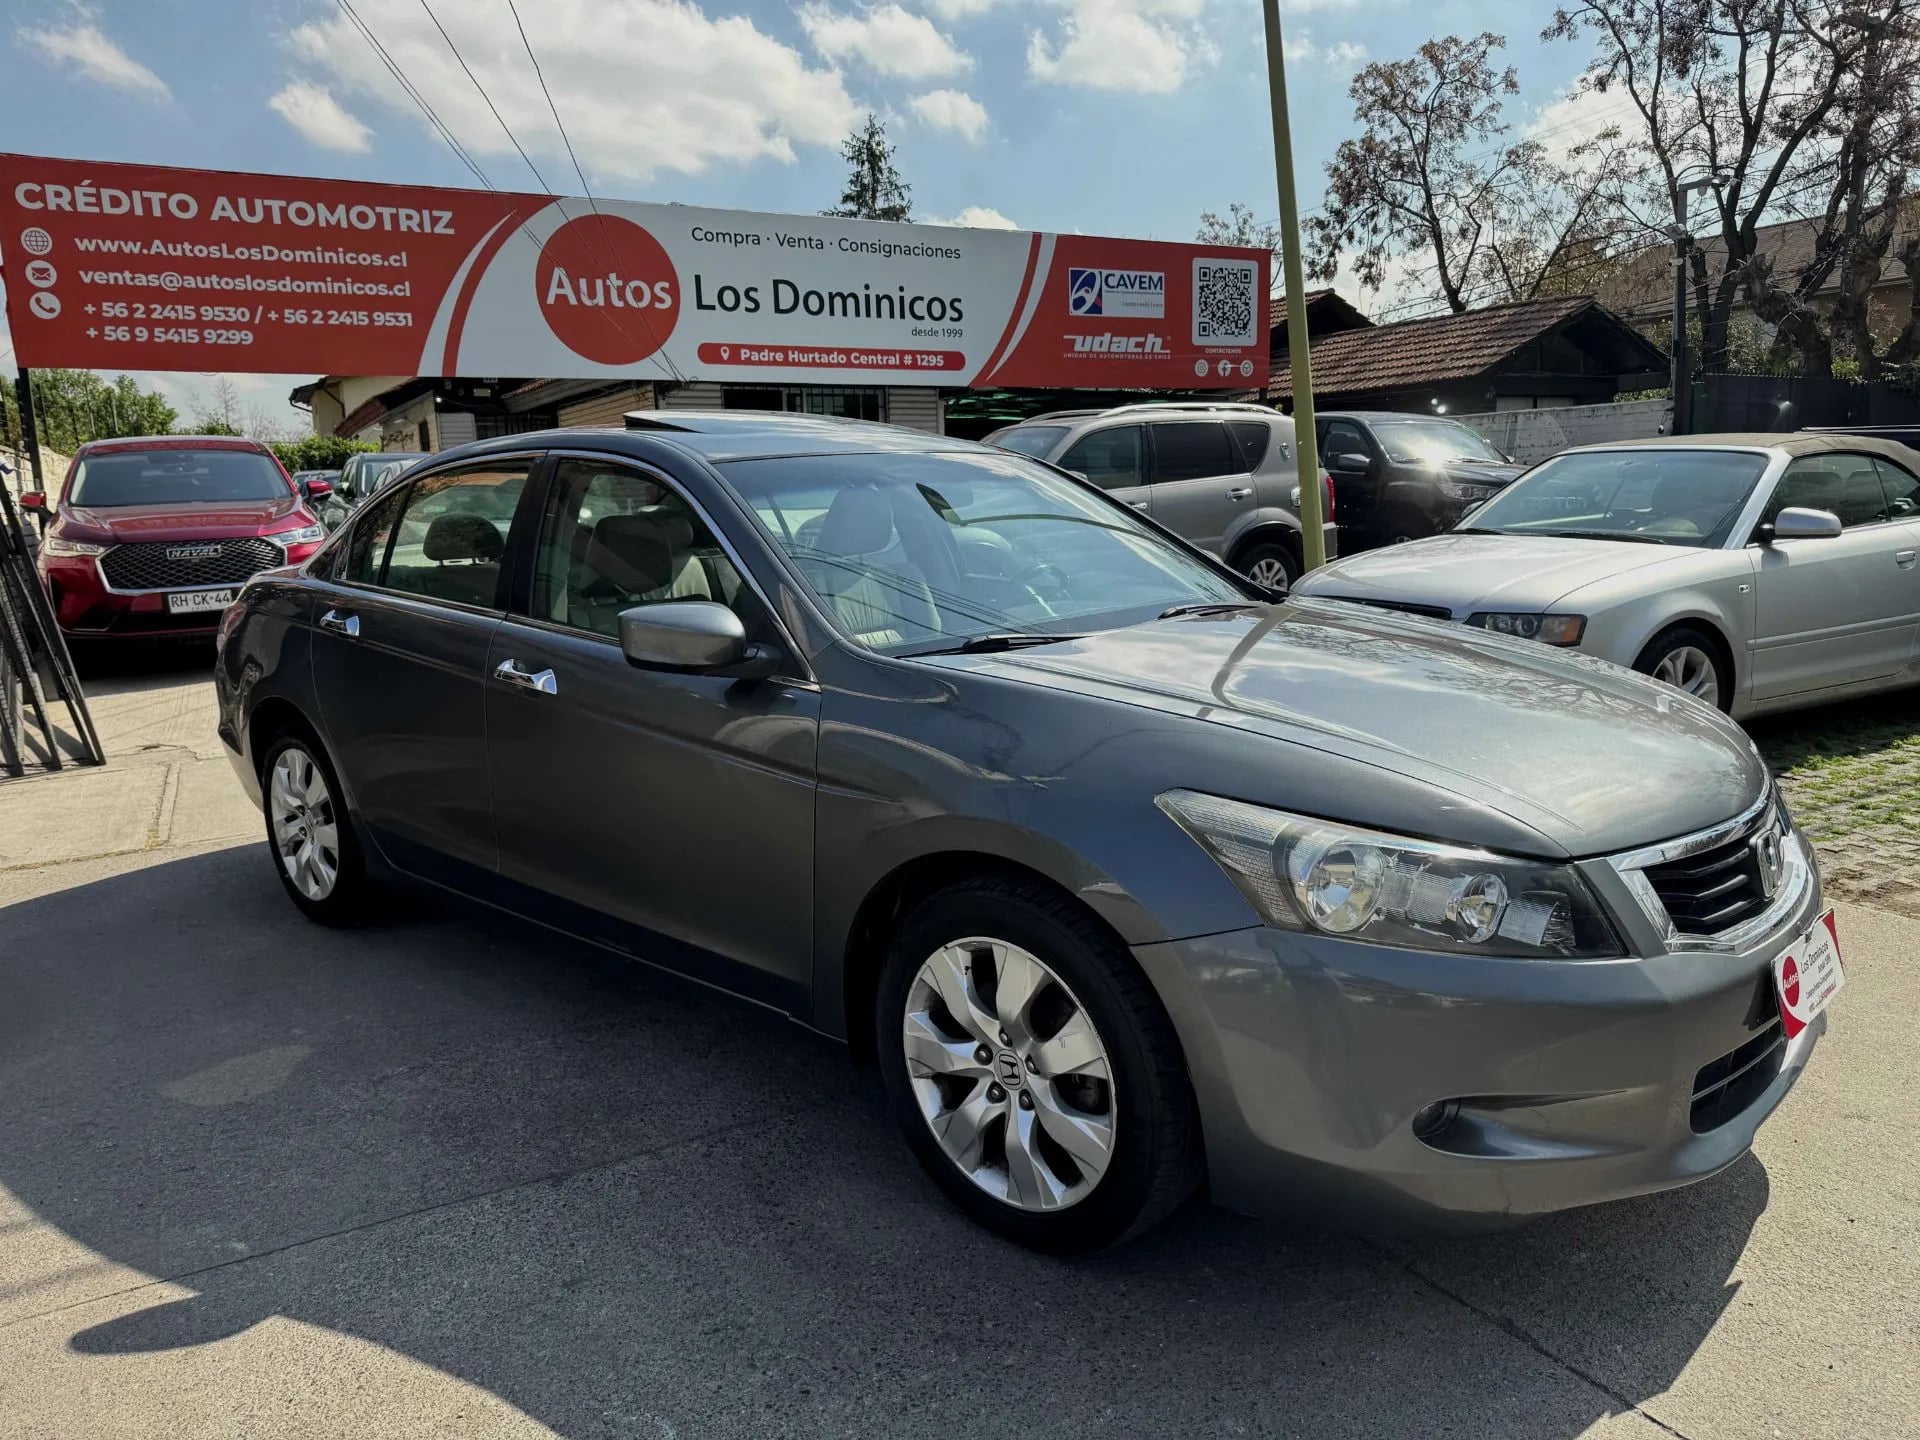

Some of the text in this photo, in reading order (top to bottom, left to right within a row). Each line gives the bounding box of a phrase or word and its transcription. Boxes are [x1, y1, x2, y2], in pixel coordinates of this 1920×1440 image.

[14, 179, 456, 234] CRÉDITO AUTOMOTRIZ
[74, 236, 408, 267] www.AutosLosDominicos.cl
[691, 226, 761, 247] Compra
[775, 233, 824, 250] Venta
[837, 237, 961, 260] Consignaciones
[79, 269, 411, 297] ventas@autoslosdominicos.cl
[546, 266, 672, 311] Autos
[1104, 273, 1163, 290] CAVEM
[693, 273, 963, 322] Los Dominicos
[102, 302, 129, 318] 56
[133, 303, 146, 318] 2
[150, 304, 196, 321] 2415
[200, 305, 250, 323] 9530
[283, 309, 309, 325] 56
[311, 309, 324, 325] 2
[327, 310, 370, 326] 2415
[374, 311, 413, 326] 9531
[104, 326, 130, 341] 56
[134, 327, 148, 342] 9
[154, 327, 199, 343] 5415
[203, 327, 253, 345] 9299
[911, 326, 963, 338] desde 1999
[740, 349, 944, 367] Padre Hurtado Central # 1295
[171, 547, 218, 558] HAVAL
[1800, 958, 1810, 975] Los
[1783, 972, 1799, 991] Autos
